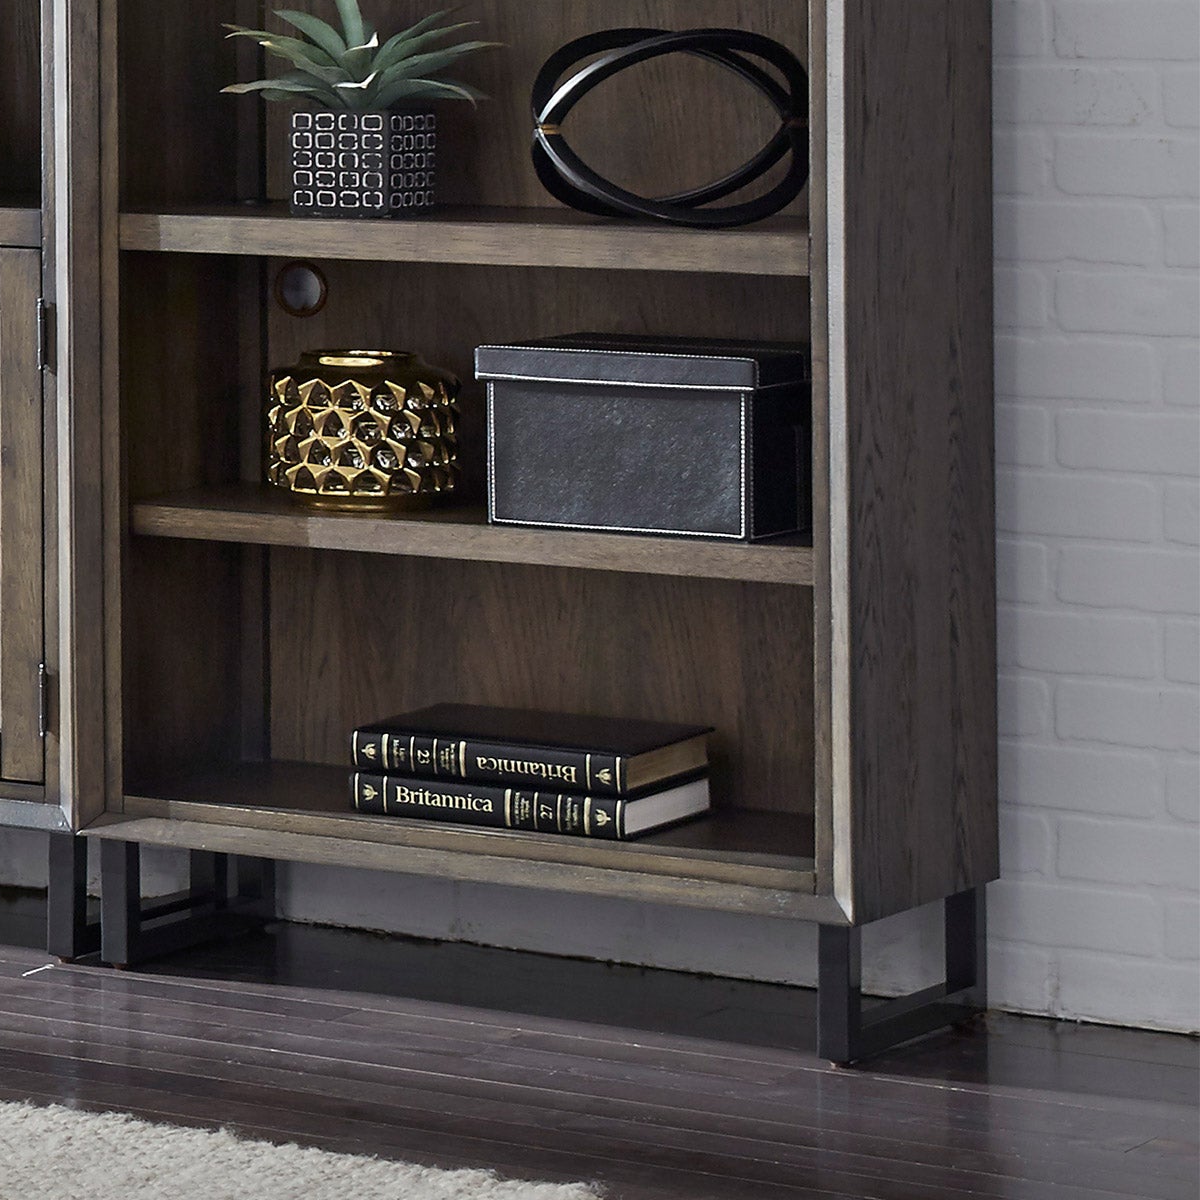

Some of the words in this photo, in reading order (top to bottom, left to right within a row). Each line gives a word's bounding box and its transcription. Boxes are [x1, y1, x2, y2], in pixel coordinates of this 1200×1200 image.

[417, 749, 430, 764] 23
[476, 756, 577, 784] Britannica
[395, 785, 494, 812] Britannica
[540, 804, 553, 820] 27
